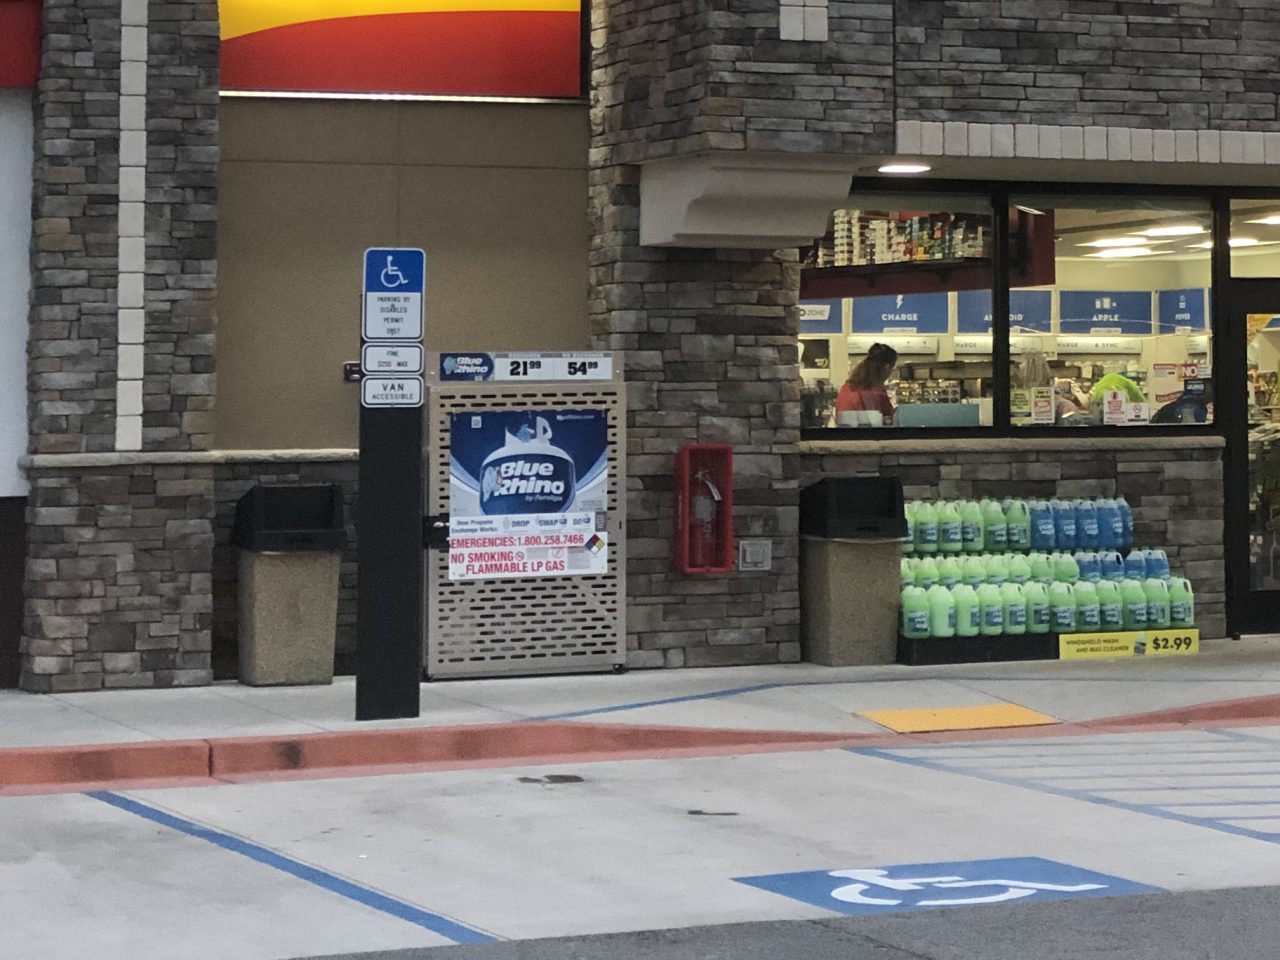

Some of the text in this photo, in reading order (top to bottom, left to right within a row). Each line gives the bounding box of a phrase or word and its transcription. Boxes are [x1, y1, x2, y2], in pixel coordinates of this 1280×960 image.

[881, 313, 919, 321] CHARGE
[1091, 313, 1120, 322] APPLE
[1182, 366, 1198, 377] NO
[381, 383, 405, 392] VAN
[500, 460, 555, 478] Blue
[451, 551, 514, 564] NO SMOKING
[466, 560, 566, 575] FLAMMABLE LP GAS
[1152, 636, 1193, 651] $2.99
